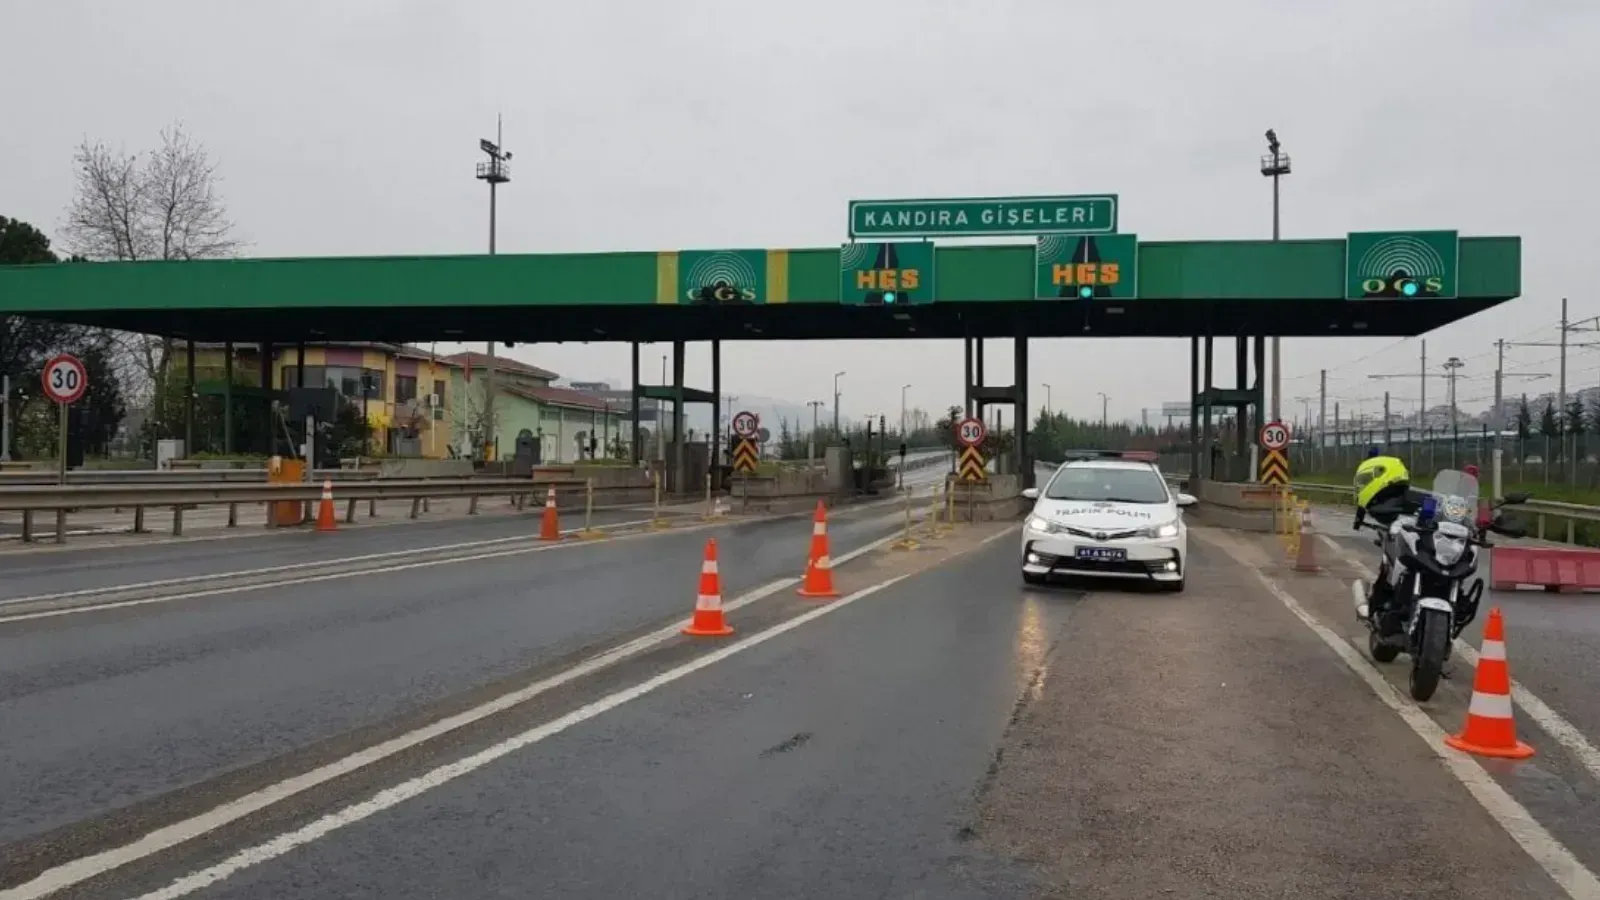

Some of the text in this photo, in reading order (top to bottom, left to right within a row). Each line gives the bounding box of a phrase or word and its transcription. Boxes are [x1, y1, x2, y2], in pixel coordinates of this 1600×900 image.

[864, 202, 1095, 227] KANDIRA GİŞELERİ
[856, 268, 919, 290] HGS
[1052, 262, 1119, 285] HGS
[52, 368, 78, 390] 30
[738, 418, 754, 431] 30
[963, 424, 980, 438] 30
[1266, 430, 1284, 443] 30
